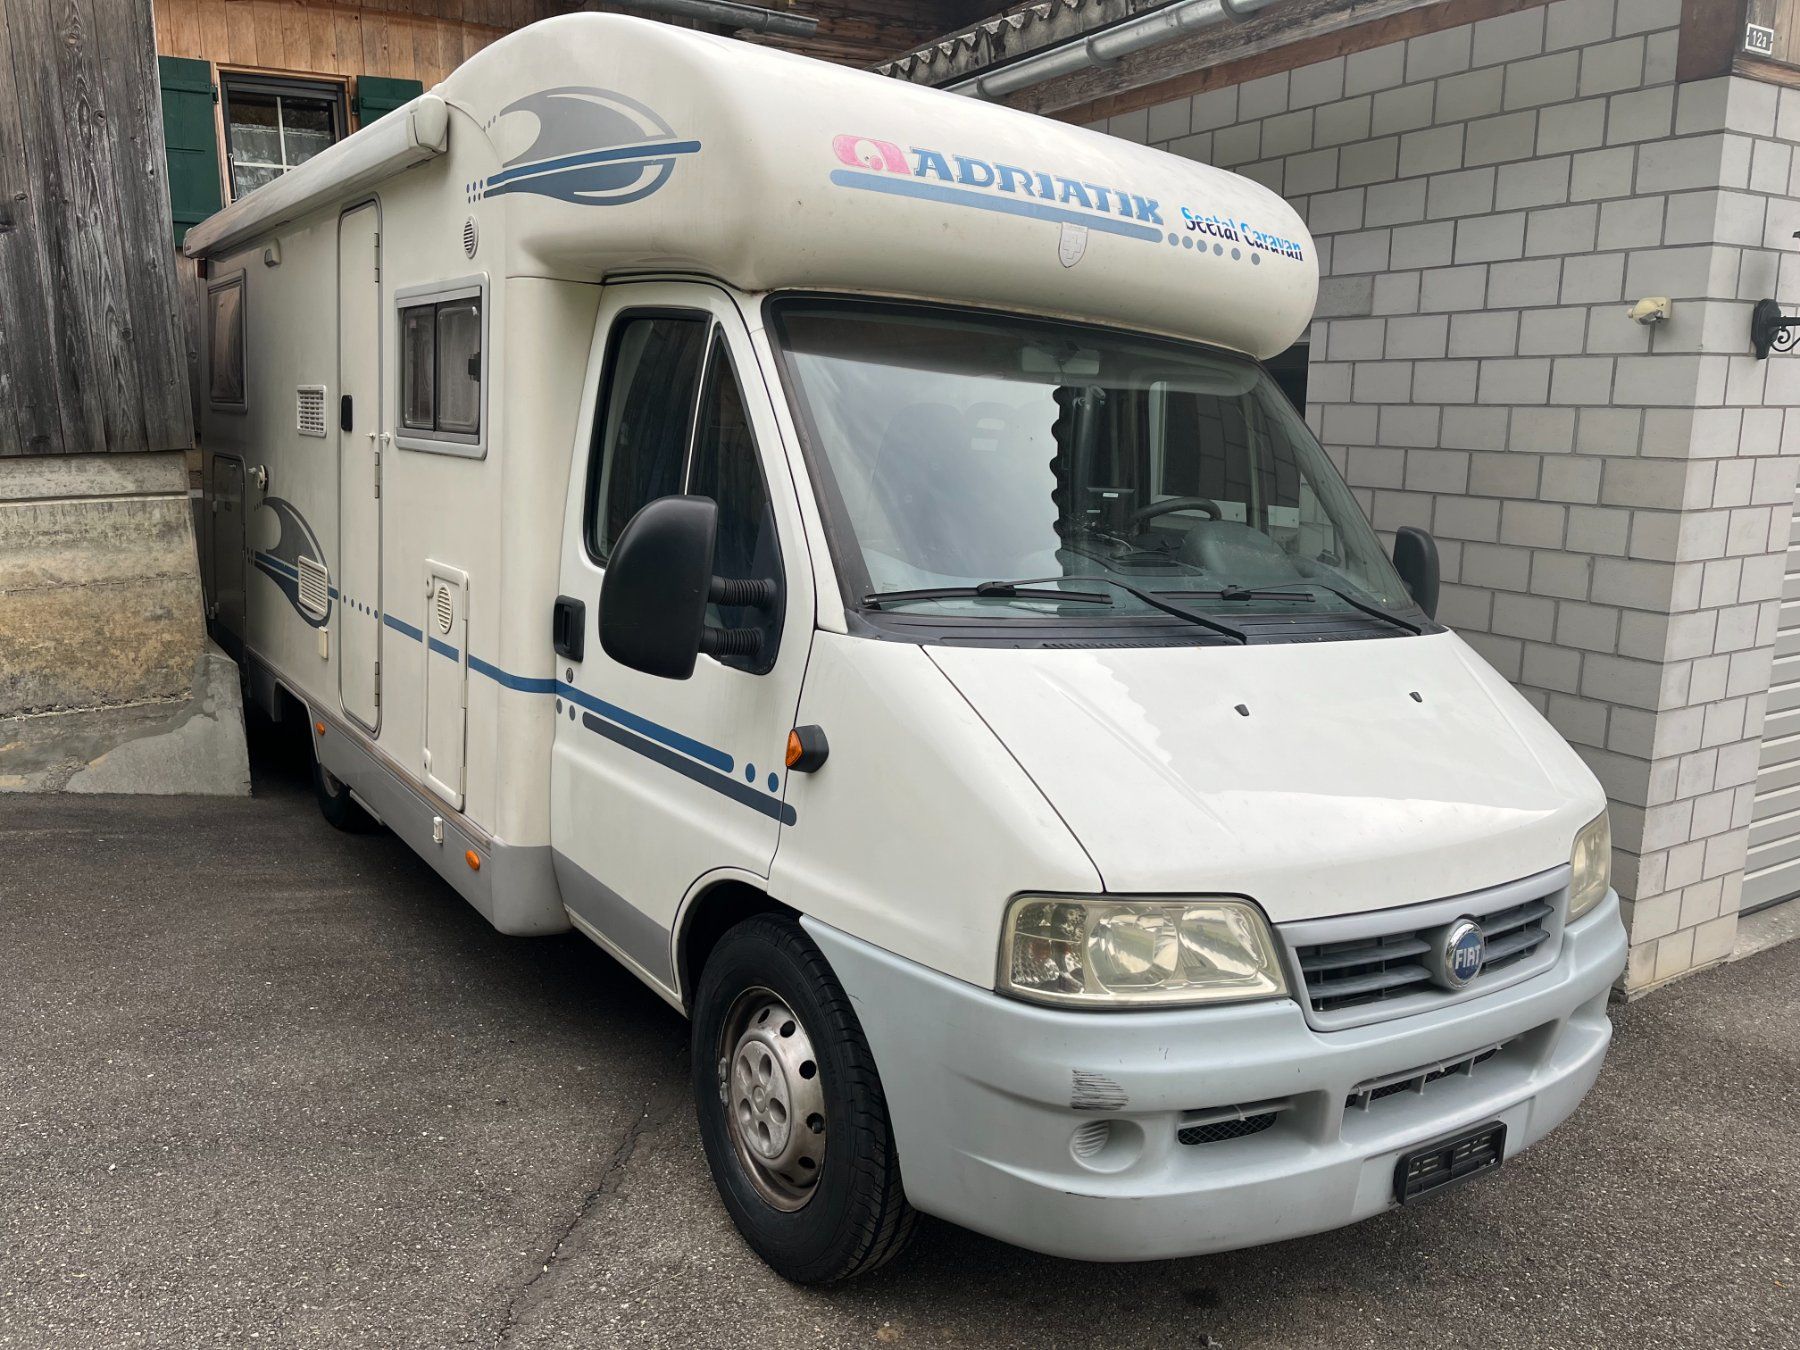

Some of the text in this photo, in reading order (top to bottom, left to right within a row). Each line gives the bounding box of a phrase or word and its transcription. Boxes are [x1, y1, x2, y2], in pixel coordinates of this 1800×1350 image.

[1752, 30, 1767, 48] 12a
[910, 146, 1164, 226] ADRIATIK
[1181, 207, 1304, 262] Seetal Caravan
[1454, 944, 1481, 970] FIAT
